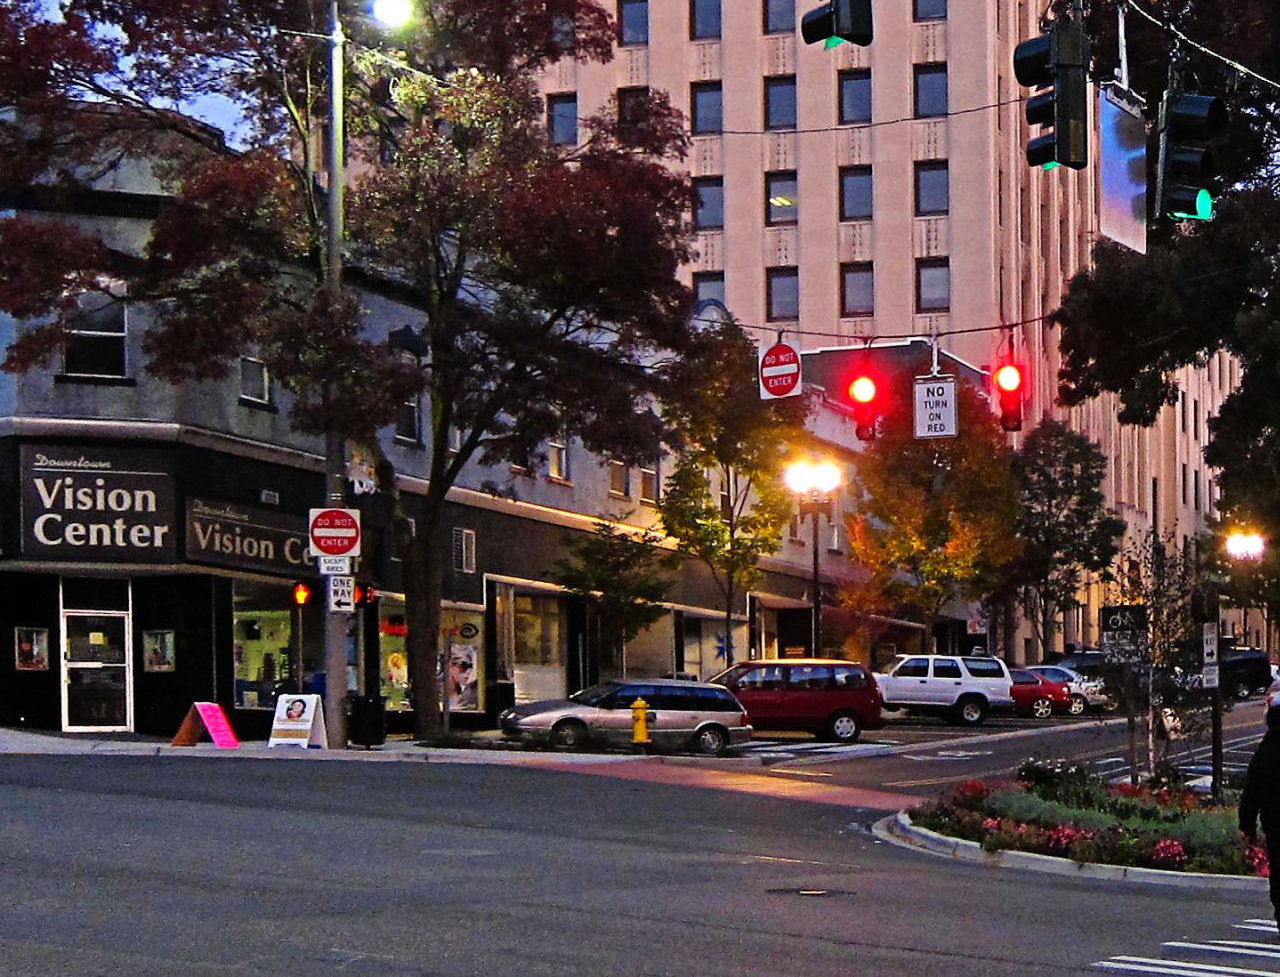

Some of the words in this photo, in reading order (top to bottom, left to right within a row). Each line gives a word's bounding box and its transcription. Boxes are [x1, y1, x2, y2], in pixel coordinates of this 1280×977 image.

[765, 355, 776, 365] DO
[779, 352, 794, 362] NOT
[769, 376, 791, 388] ENTER
[926, 386, 945, 397] NO
[924, 400, 947, 409] TURN
[929, 412, 941, 421] ON
[927, 423, 946, 433] RED
[33, 453, 112, 468] Downtown
[33, 477, 156, 512] Vision
[317, 518, 330, 526] DO
[334, 518, 352, 526] NOT
[33, 513, 169, 547] Center
[192, 522, 275, 560] Vision
[320, 538, 349, 547] ENTER
[332, 578, 352, 588] ONE
[332, 588, 352, 598] WAY
